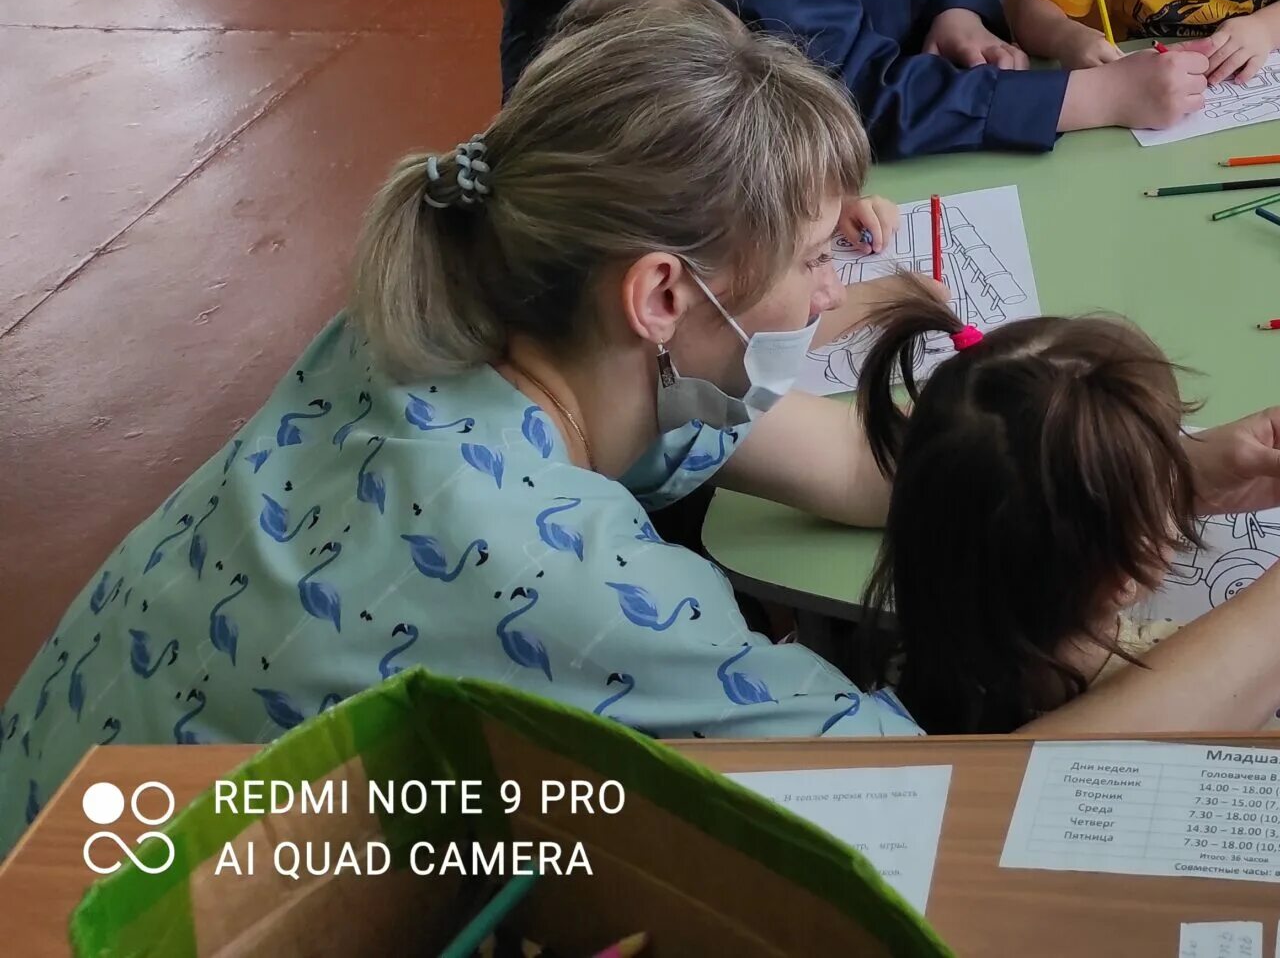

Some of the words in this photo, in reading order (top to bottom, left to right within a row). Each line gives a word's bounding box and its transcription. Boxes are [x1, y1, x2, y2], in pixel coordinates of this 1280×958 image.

[1071, 761, 1093, 772] Дни
[1097, 764, 1140, 774] недели
[1063, 774, 1141, 787] Понедельник
[1201, 769, 1266, 781] Головачева
[1074, 789, 1123, 801] Вторник
[1199, 783, 1229, 793] 14.00
[1242, 786, 1273, 795] 18.00
[1078, 803, 1113, 814] Среда
[1195, 797, 1219, 806] 7.30
[1231, 799, 1262, 808] 15.00
[1189, 810, 1213, 819] 7.30
[1226, 813, 1257, 822] 18.00
[1070, 817, 1115, 829] Четверг
[1186, 824, 1218, 834] 14.30
[1230, 826, 1261, 836] 18.00
[1063, 831, 1114, 843] Пятница
[1184, 838, 1208, 848] 7.30
[1222, 840, 1253, 850] 18.00
[1231, 854, 1241, 862] 36
[1174, 863, 1239, 875] Совместные
[1244, 867, 1272, 876] часы:
